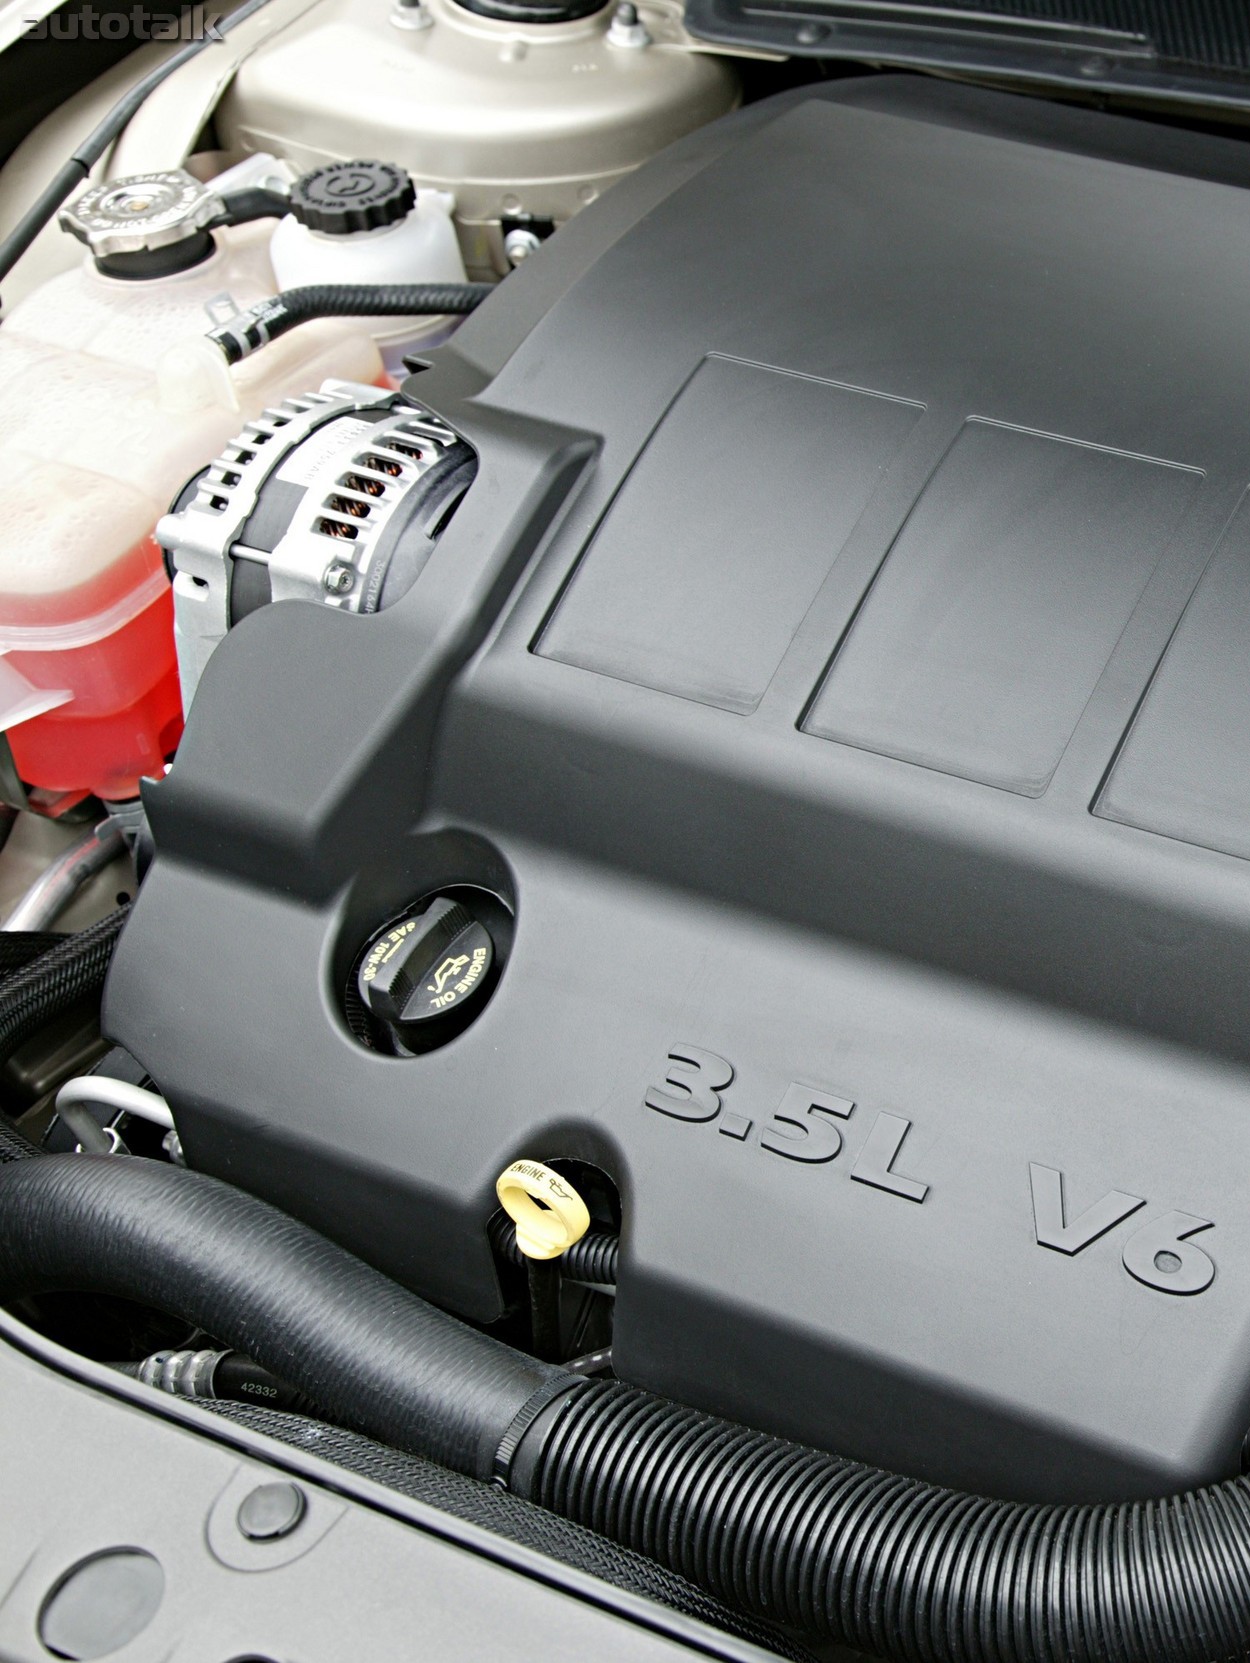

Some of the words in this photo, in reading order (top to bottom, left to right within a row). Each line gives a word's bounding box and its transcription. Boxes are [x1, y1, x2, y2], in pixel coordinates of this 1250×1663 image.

[454, 947, 487, 993] ENGINE
[430, 991, 456, 1008] OIL
[510, 1163, 547, 1182] ENGINE
[644, 1041, 930, 1205] 3.5L
[1028, 1161, 1217, 1297] V6
[240, 1382, 278, 1398] 42332
